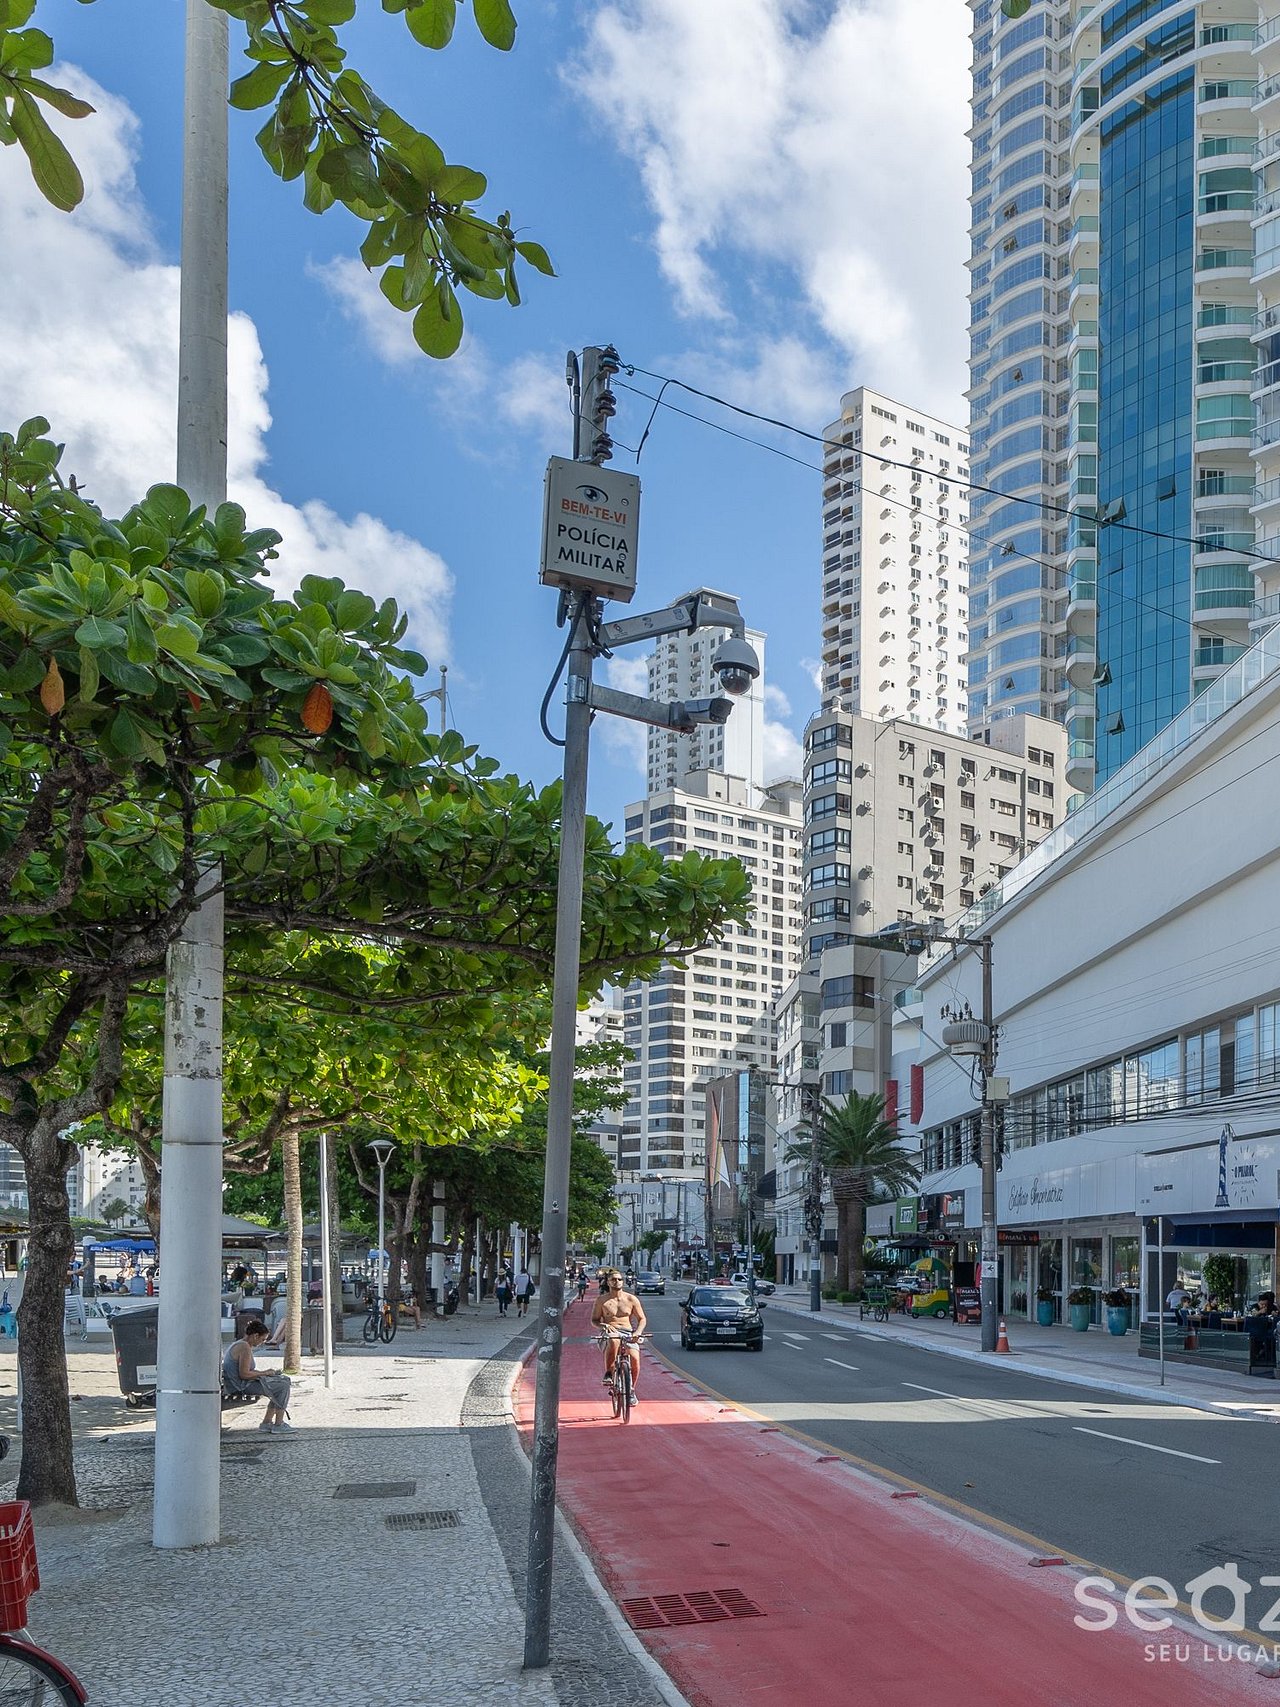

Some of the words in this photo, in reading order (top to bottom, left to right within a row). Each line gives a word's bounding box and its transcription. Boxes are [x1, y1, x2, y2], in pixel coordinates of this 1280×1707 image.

[561, 498, 627, 525] BEM-TE-VI
[558, 523, 629, 553] POLÍCIA
[558, 546, 625, 574] MILITAR
